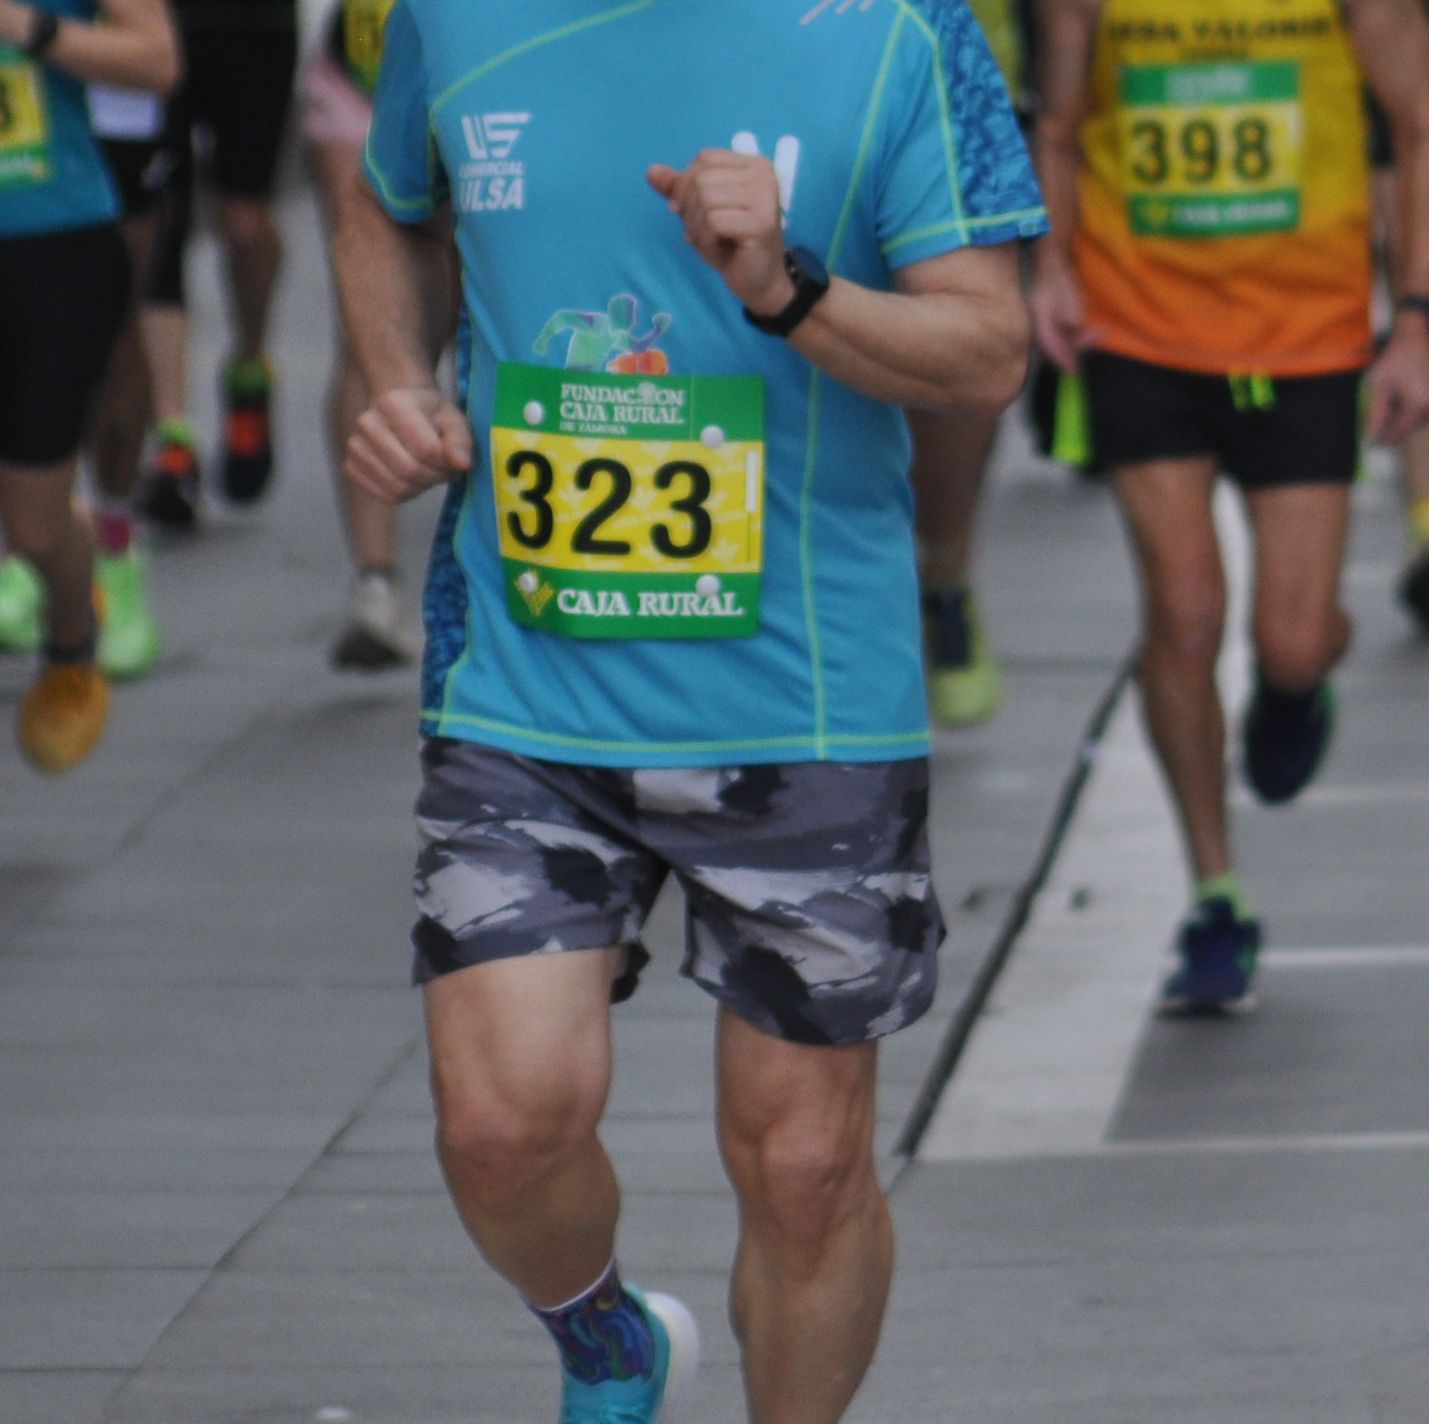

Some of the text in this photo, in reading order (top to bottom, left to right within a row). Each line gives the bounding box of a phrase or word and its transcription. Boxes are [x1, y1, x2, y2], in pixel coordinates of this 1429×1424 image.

[1131, 119, 1272, 183] 398
[560, 401, 686, 425] CAJA RURAL
[506, 449, 712, 559] 323
[556, 588, 745, 617] CAJA RURAL
